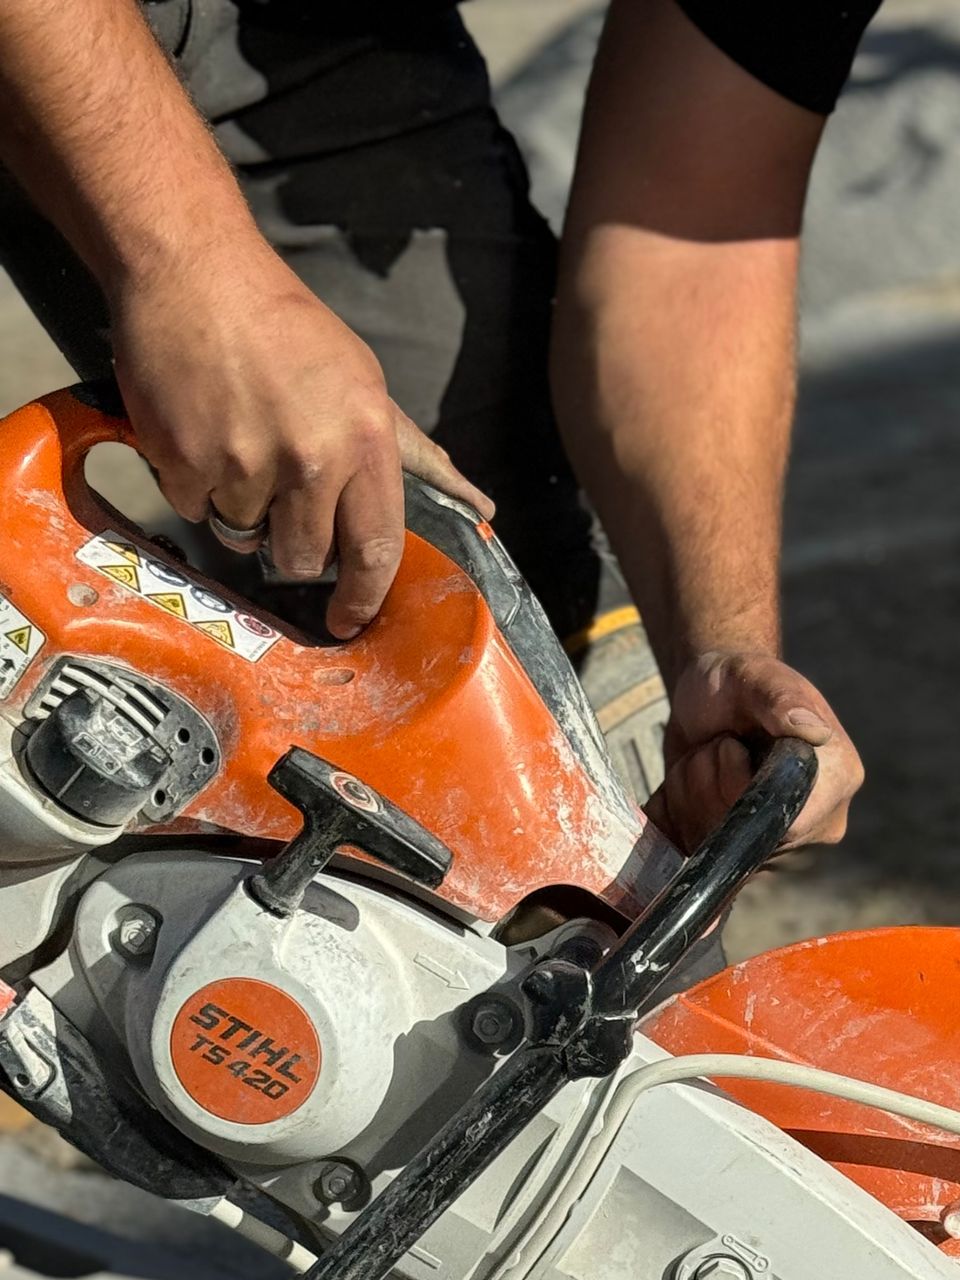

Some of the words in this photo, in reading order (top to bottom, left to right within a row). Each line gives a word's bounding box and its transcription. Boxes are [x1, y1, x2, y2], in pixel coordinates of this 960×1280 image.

[189, 1003, 302, 1084] STIHL
[189, 1033, 232, 1065] TS
[227, 1060, 290, 1100] 420
